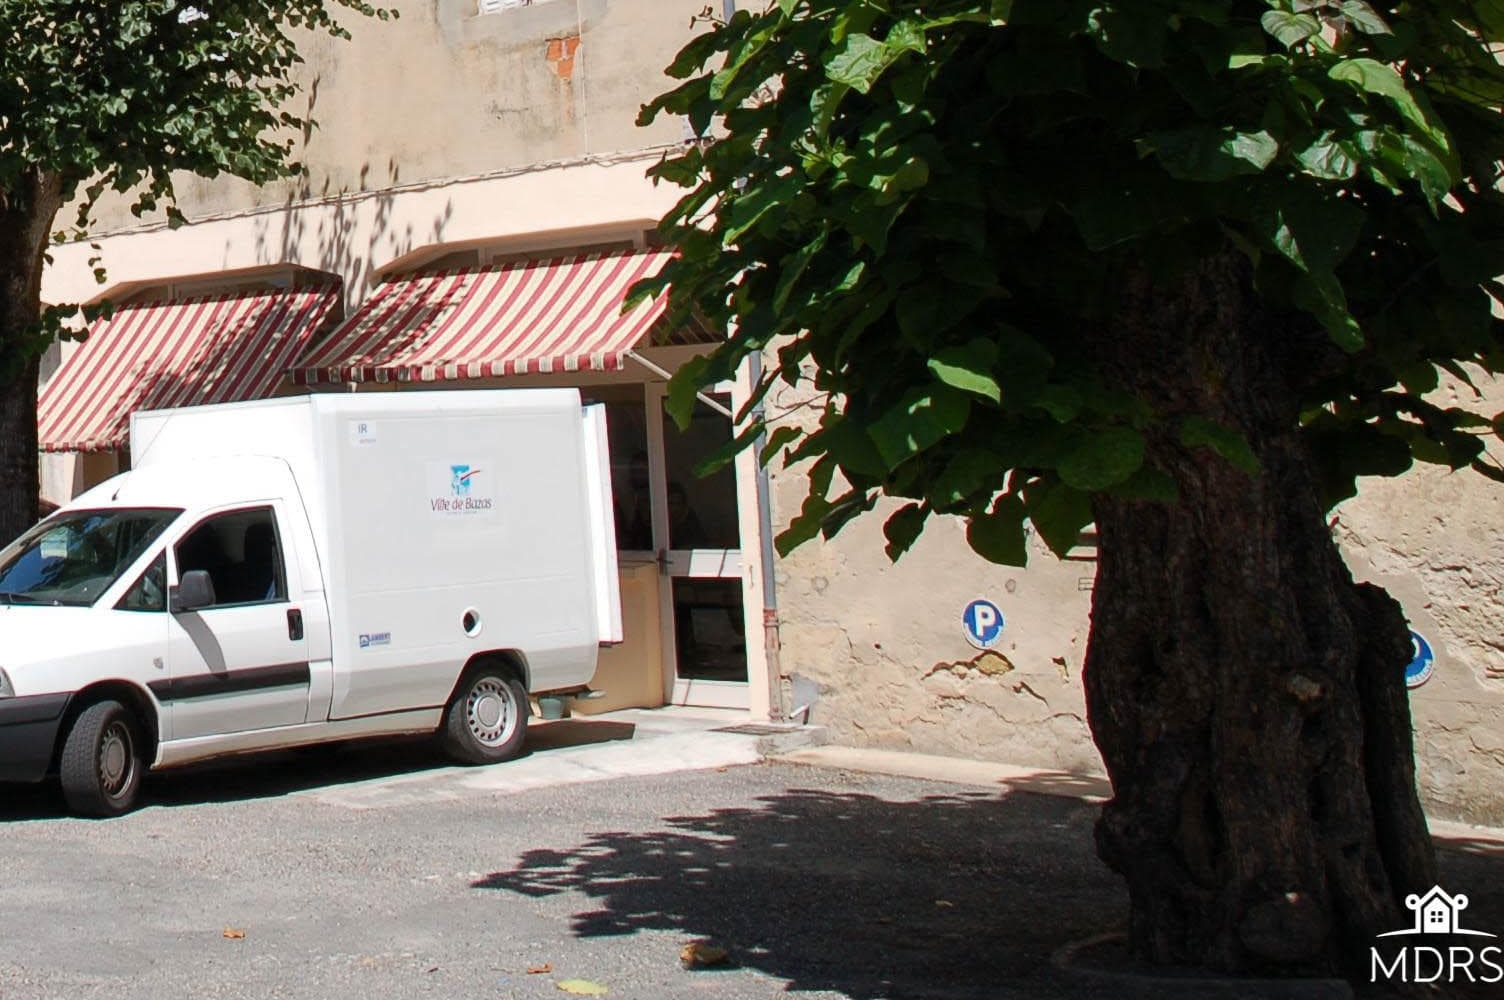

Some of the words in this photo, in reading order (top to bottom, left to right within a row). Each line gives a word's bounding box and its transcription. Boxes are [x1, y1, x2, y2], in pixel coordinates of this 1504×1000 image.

[431, 497, 450, 511] Ville
[451, 497, 463, 510] de
[465, 497, 492, 510] Bazas
[974, 604, 996, 637] P
